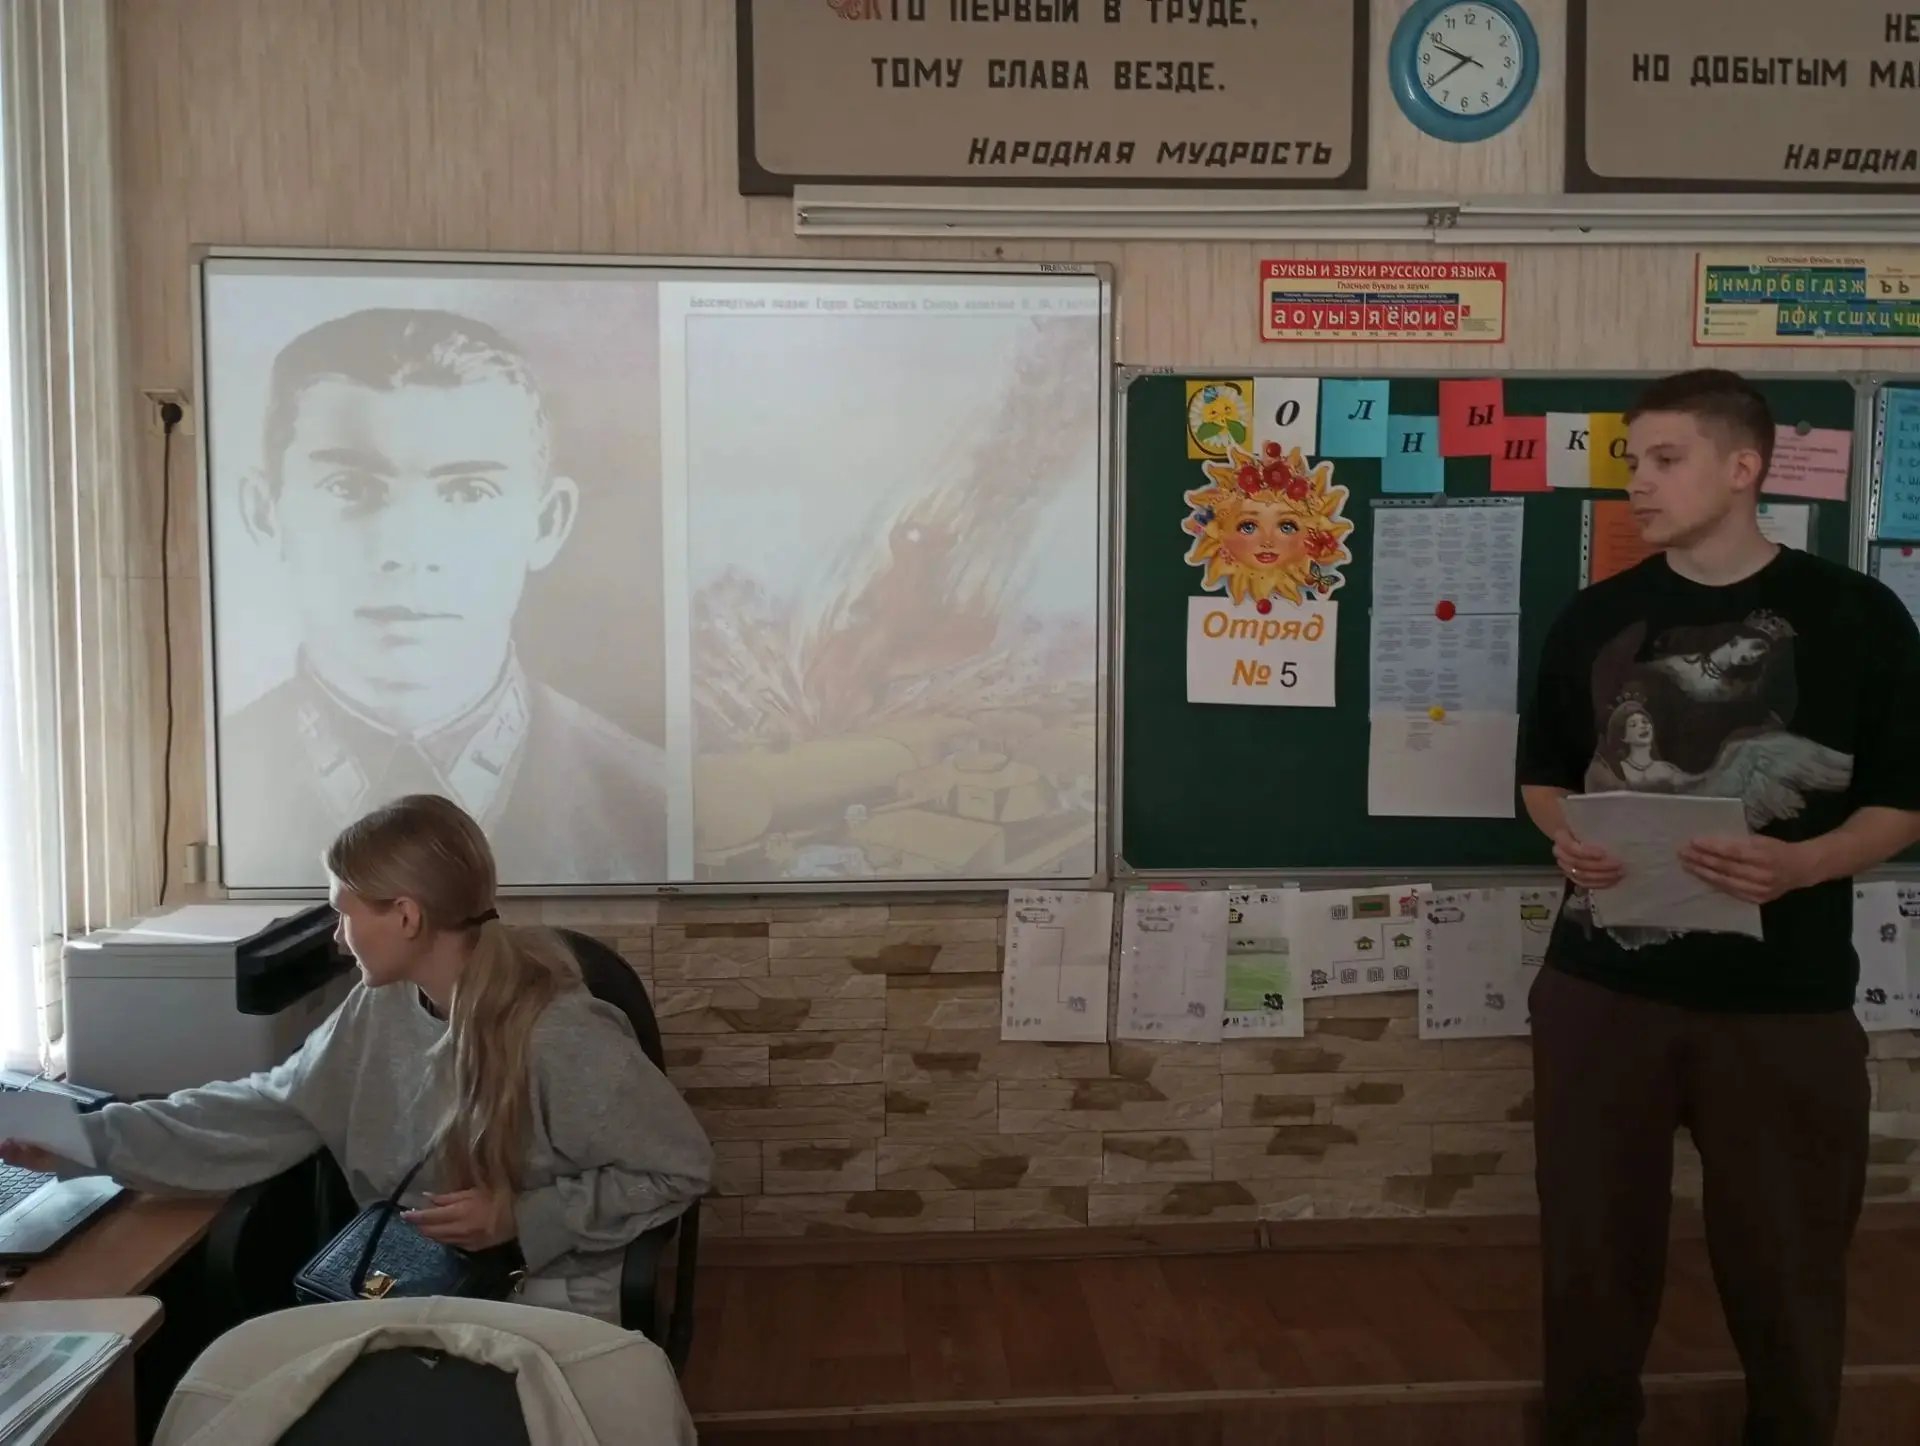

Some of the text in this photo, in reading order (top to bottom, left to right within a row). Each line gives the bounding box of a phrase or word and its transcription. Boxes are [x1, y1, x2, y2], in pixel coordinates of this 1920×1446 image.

[951, 0, 1080, 23] ПЕРВЫЙ
[1104, 0, 1121, 23] В
[1146, 0, 1258, 28] ТРУДЕ,
[1464, 13, 1476, 25] 12
[1446, 18, 1456, 29] 11
[1486, 19, 1492, 30] 1
[1428, 32, 1443, 44] 10
[1499, 35, 1508, 47] 2
[1422, 53, 1431, 65] 9
[1503, 56, 1512, 69] 3
[870, 57, 1226, 93] ТОМУ СЛАВА ВЕЗДЕ.
[1632, 53, 1920, 89] НО ДОБЫТЫМ МА
[1426, 74, 1436, 87] 8
[1496, 77, 1506, 88] 4
[1441, 90, 1450, 102] 7
[1460, 96, 1469, 109] 6
[1480, 92, 1489, 104] 5
[966, 137, 1333, 168] НАРОДНАЯ МУДРОСТЬ
[1271, 264, 1497, 278] БУКВЫ И ЗВУКИ РУССКОГО ЯЗЫКА
[1203, 611, 1325, 647] Отряд
[1232, 659, 1298, 688] № 5
